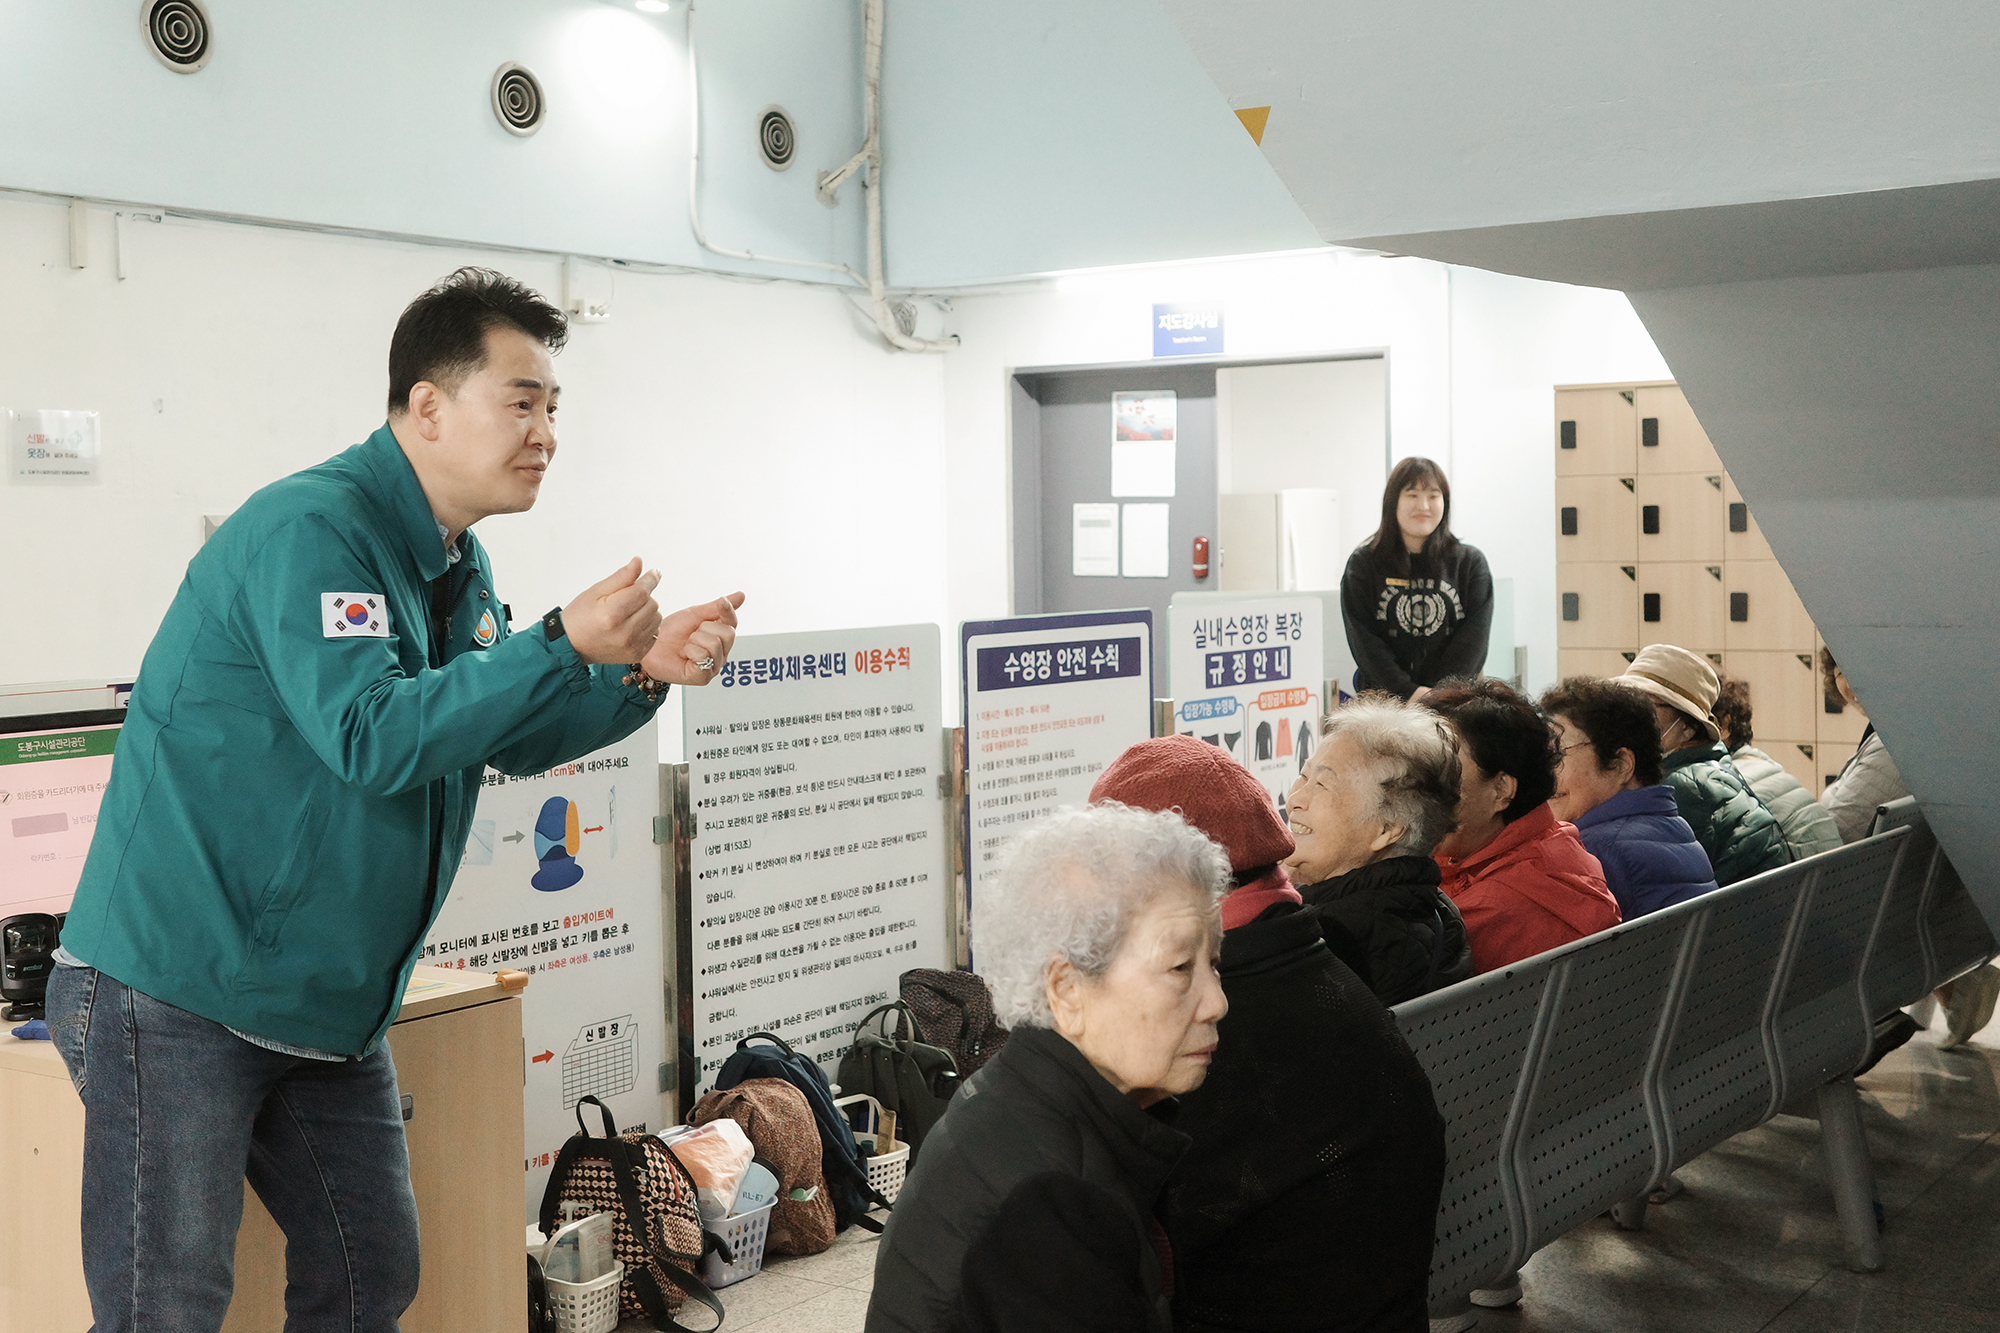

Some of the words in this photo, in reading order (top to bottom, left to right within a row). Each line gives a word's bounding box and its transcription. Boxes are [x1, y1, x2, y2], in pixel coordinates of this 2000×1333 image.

[1193, 614, 1268, 649] 실내수영장
[1276, 612, 1302, 641] 복장
[855, 647, 910, 674] 이용수칙
[1004, 650, 1052, 682] 수영장
[1057, 646, 1087, 677] 안전
[1090, 644, 1120, 674] 수칙
[1184, 702, 1212, 719] 입장가능
[1215, 698, 1235, 714] 수영복
[1260, 692, 1286, 709] 입장금지
[1288, 690, 1306, 705] 수영복
[702, 725, 722, 735] 샤워실
[730, 722, 748, 733] 탈의실
[752, 719, 770, 730] 입장은
[773, 714, 822, 728] 창동문화체육센터
[825, 712, 842, 721] 회원에
[18, 737, 86, 752] 도봉구시설관리공단
[703, 748, 729, 759] 회원증은
[732, 744, 758, 755] 타인에게
[761, 742, 774, 752] 양도
[777, 741, 789, 750] 또는
[792, 738, 810, 748] 대여할
[821, 735, 841, 744] 없으며,
[549, 763, 585, 778] 1cm앞에
[588, 757, 629, 771] 대어주세요
[714, 772, 726, 783] 경우
[729, 767, 761, 780] 회원자격이
[764, 763, 797, 776] 상실됩니다.
[46, 785, 86, 796] 카드리더기에
[704, 797, 717, 808] 분실
[720, 794, 739, 805] 우려가
[742, 792, 754, 802] 있는
[758, 786, 793, 799] 귀중품(현금,
[796, 784, 808, 793] 보석
[827, 778, 845, 789] 반드시
[705, 821, 724, 831] 주시고
[728, 816, 753, 828] 보관하지
[756, 813, 768, 823] 않은
[772, 809, 796, 820] 귀중품의
[798, 806, 812, 816] 도난,
[816, 804, 827, 814] 분실
[838, 798, 860, 810] 공단에서
[705, 844, 721, 856] (상법
[724, 839, 751, 852] 제153조)
[706, 869, 718, 879] 락커
[722, 867, 728, 876] 키
[731, 864, 743, 875] 분실
[746, 862, 752, 871] 시
[756, 856, 787, 870] 변상하여야
[813, 848, 830, 860] 분실로
[833, 846, 845, 856] 인한
[706, 890, 735, 904] 않습니다.
[706, 915, 726, 928] 탈의실
[729, 908, 760, 923] 입장시간은
[764, 905, 775, 916] 강습
[778, 899, 802, 912] 이용시간
[805, 896, 818, 906] 30분
[820, 894, 828, 904] 전,
[831, 887, 859, 900] 퇴장시간은
[440, 937, 478, 954] 모니터에
[481, 929, 508, 945] 표시된
[512, 922, 539, 939] 번호를
[542, 920, 559, 933] 보고
[563, 907, 614, 928] 출입게이트에
[707, 940, 720, 950] 다른
[723, 935, 742, 948] 분들을
[746, 932, 758, 942] 위해
[761, 928, 779, 938] 샤워는
[803, 918, 821, 930] 간단히
[824, 916, 835, 924] 하여
[838, 911, 855, 922] 주시기
[456, 957, 465, 970] 후
[470, 952, 488, 967] 해당
[492, 945, 528, 962] 신발장에
[532, 938, 558, 955] 신발을
[562, 934, 578, 949] 넣고
[582, 930, 598, 944] 키를
[602, 926, 618, 939] 뽑은
[622, 923, 630, 935] 후
[539, 963, 546, 972] 시
[548, 959, 567, 970] 좌측은
[569, 954, 591, 966] 여성용,
[593, 949, 611, 961] 우측은
[614, 943, 635, 958] 남성용)
[708, 962, 727, 975] 위생과
[730, 954, 762, 969] 수질관리를
[765, 951, 777, 961] 위해
[780, 944, 804, 957] 대소변을
[807, 942, 818, 950] 가릴
[830, 937, 841, 946] 없는
[708, 982, 747, 998] 샤워실에서는
[750, 975, 775, 988] 안전사고
[778, 971, 790, 982] 방지
[802, 961, 831, 976] 위생관리상
[834, 956, 851, 968] 일체의
[707, 1035, 722, 1047] 본인
[725, 1030, 744, 1042] 과실로
[762, 1020, 780, 1032] 시설물
[784, 1014, 802, 1026] 파손은
[805, 1008, 822, 1021] 공단이
[825, 1005, 836, 1015] 일체
[839, 998, 862, 1010] 책임지지
[709, 1008, 737, 1023] 금합니다.
[707, 1059, 722, 1071] 본인
[805, 1032, 816, 1044] 일체
[820, 1025, 843, 1038] 책임지지
[817, 1052, 834, 1064] 흡연은
[532, 1153, 550, 1167] 키를
